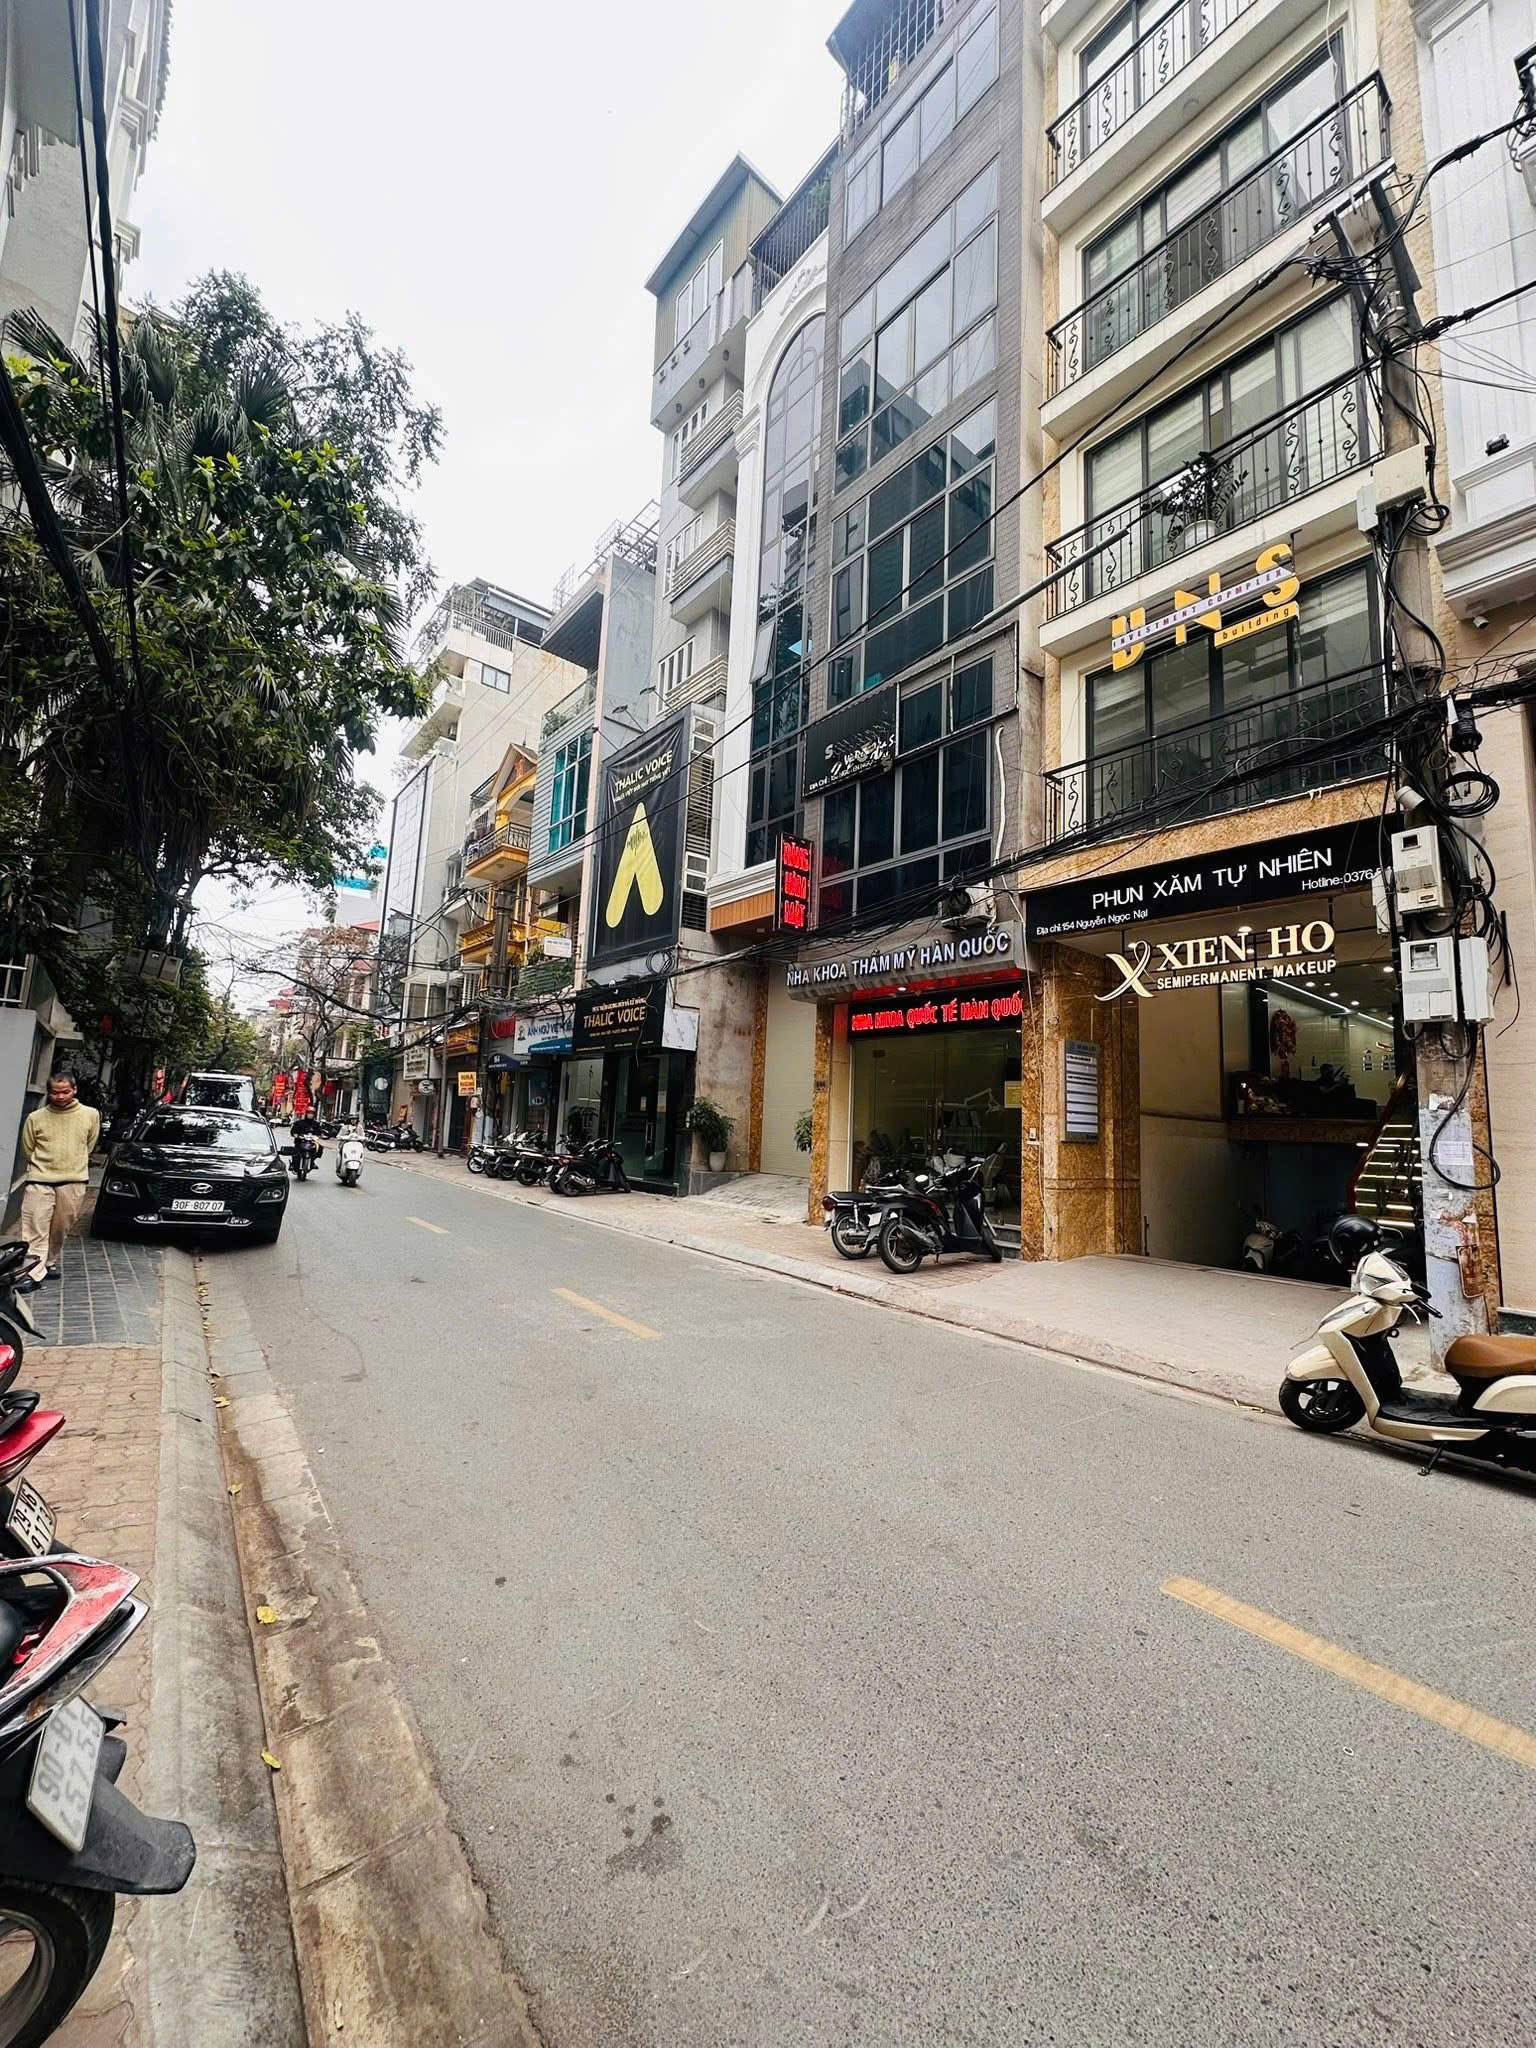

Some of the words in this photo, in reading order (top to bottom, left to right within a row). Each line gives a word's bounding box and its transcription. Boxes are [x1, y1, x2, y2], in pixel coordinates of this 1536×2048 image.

[1113, 605, 1197, 648] INVESTMENT
[1222, 608, 1290, 640] building
[615, 767, 644, 793] THALIC
[645, 750, 673, 775] VOICE
[1092, 885, 1143, 909] PHUN
[1153, 874, 1202, 898] XĂM
[1212, 864, 1247, 888] TỰ
[1258, 848, 1332, 879] NHIÊN
[1108, 913, 1131, 925] Ngọc
[786, 969, 810, 987] NHA
[813, 963, 847, 981] KHOA
[893, 943, 916, 969] MỸ
[920, 940, 955, 966] HÀN
[959, 922, 1009, 958] QUỐC
[1156, 931, 1250, 972] XIEN
[1267, 920, 1335, 959] HO
[1273, 959, 1337, 979] MAKEUP
[583, 1011, 616, 1029] THALIC
[617, 1006, 646, 1024] VOICE
[906, 1001, 938, 1028] QUỐC
[941, 998, 958, 1022] TẾ
